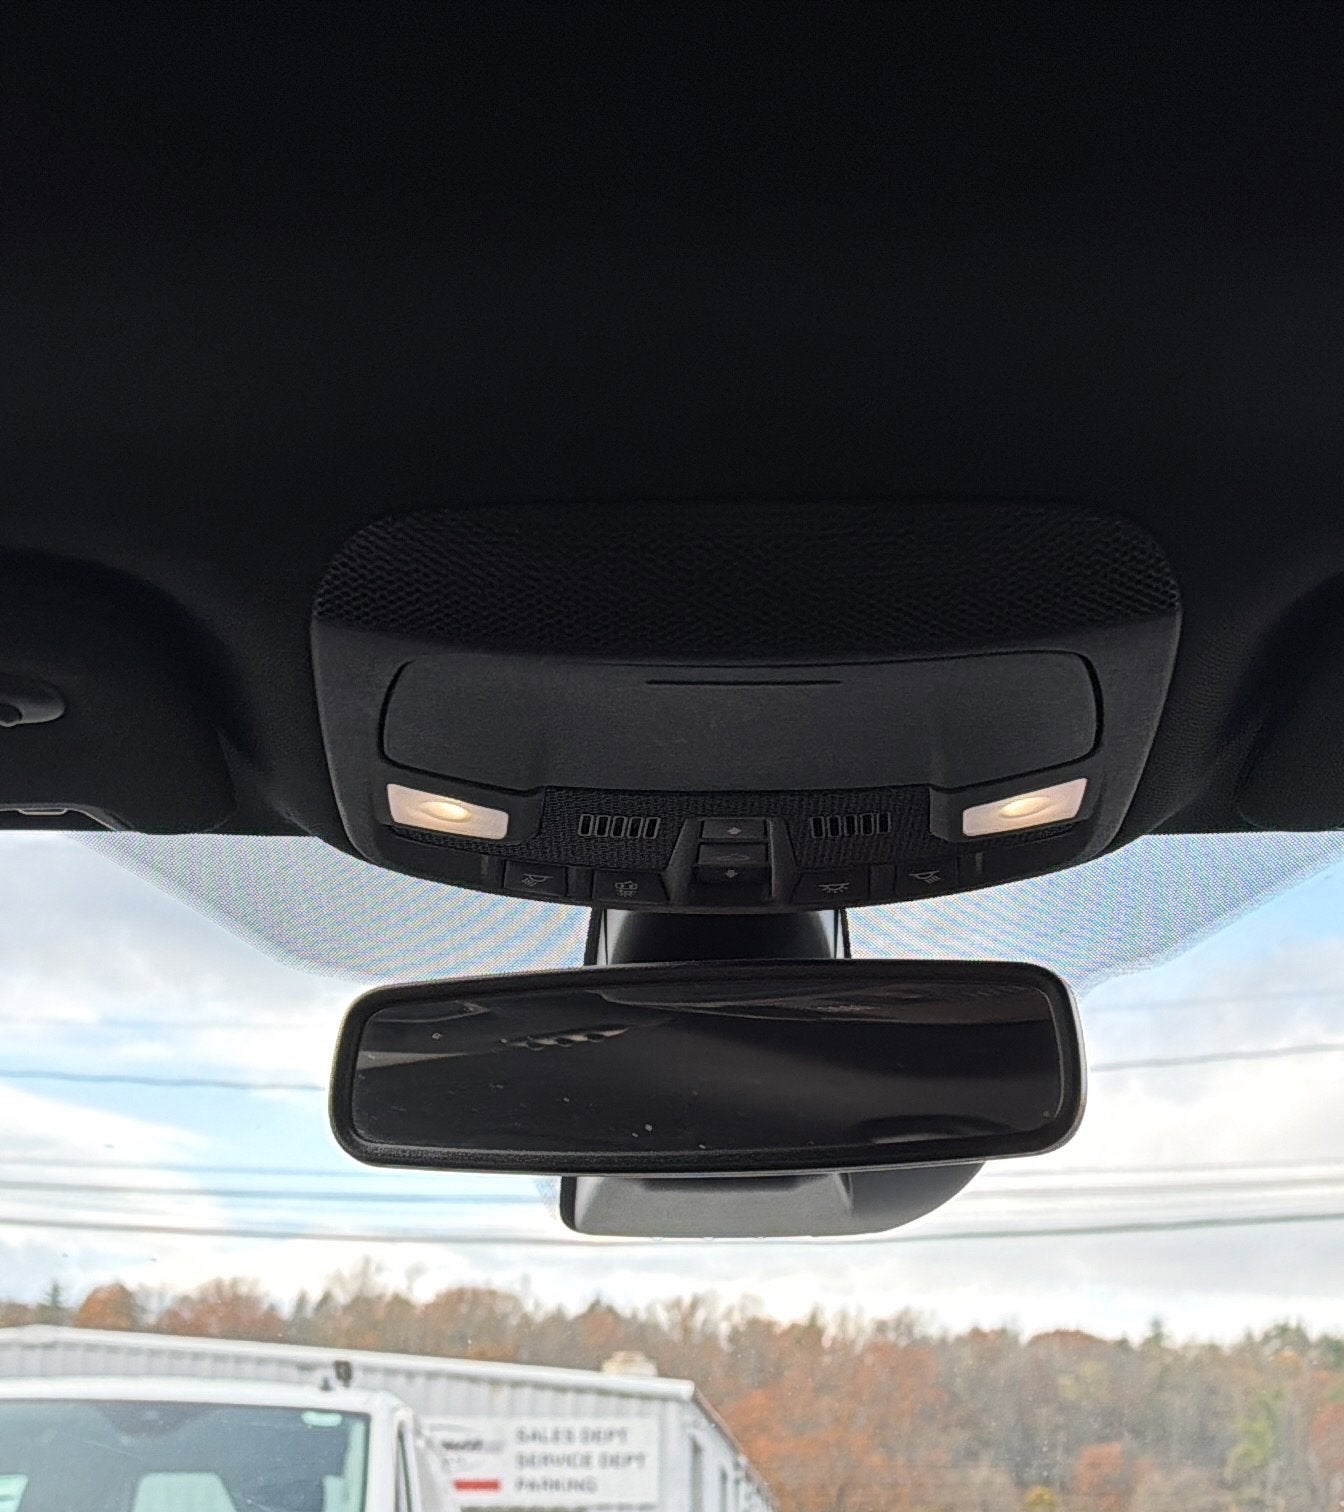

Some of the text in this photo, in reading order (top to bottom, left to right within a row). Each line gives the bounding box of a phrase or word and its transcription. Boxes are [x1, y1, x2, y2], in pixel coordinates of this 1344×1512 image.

[515, 1425, 576, 1444] SALES
[515, 1450, 594, 1470] SERVICE
[514, 1476, 599, 1493] PARKING
